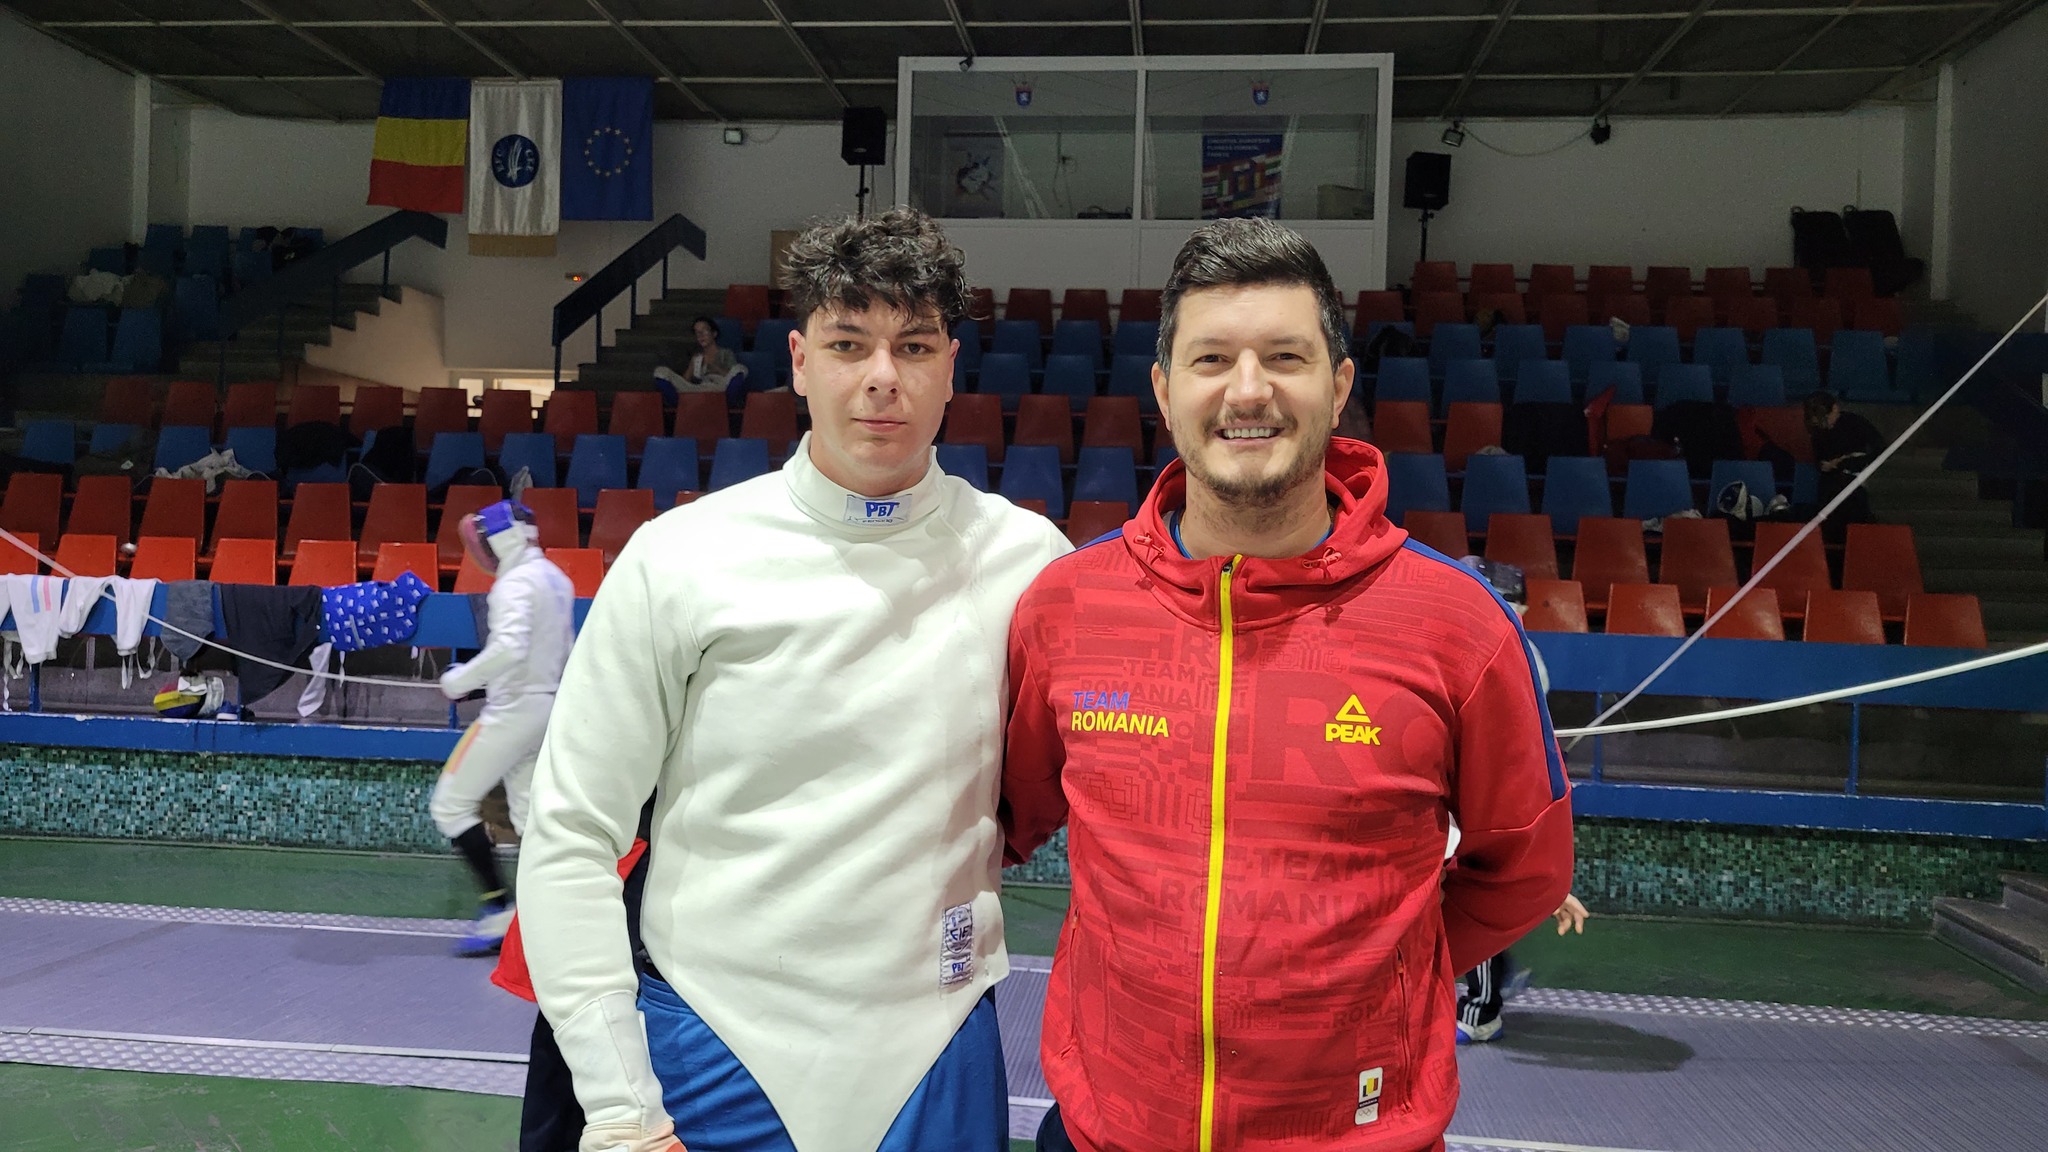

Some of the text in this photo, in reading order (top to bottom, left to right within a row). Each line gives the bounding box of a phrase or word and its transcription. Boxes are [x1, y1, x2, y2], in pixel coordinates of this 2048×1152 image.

[865, 501, 900, 518] PBT
[1072, 691, 1131, 711] TEAM
[1071, 710, 1170, 738] ROMANIA
[1325, 723, 1383, 746] PEAK
